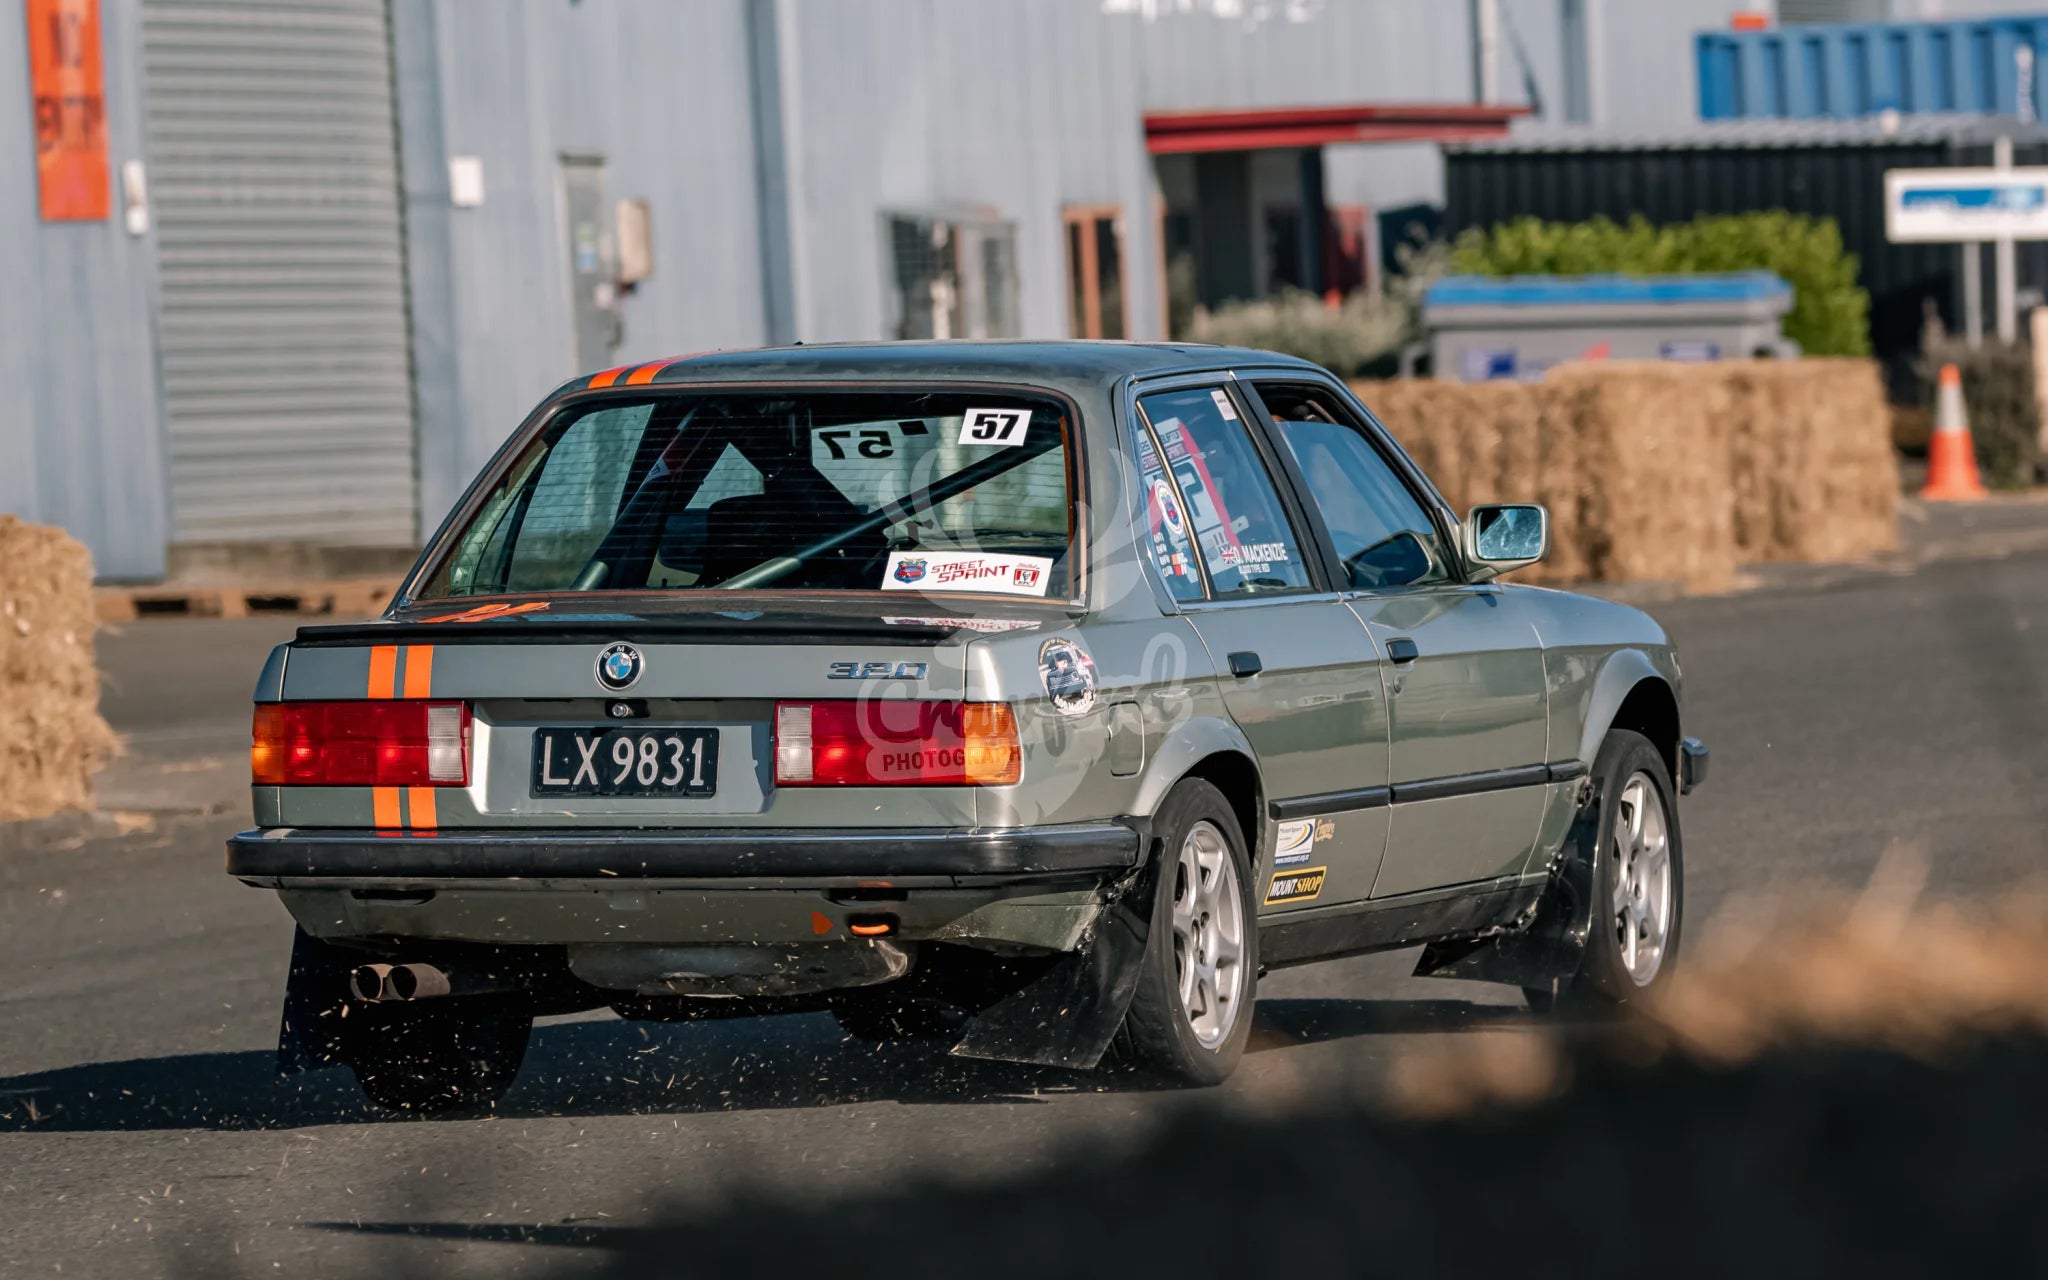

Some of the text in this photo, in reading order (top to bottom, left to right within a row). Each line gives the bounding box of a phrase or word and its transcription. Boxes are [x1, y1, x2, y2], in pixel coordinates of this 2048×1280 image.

[971, 412, 1020, 440] 57
[1241, 543, 1288, 563] MACKENZIE
[931, 560, 986, 574] STREET
[937, 565, 1010, 583] SPRINT
[604, 646, 637, 660] BMW
[827, 662, 928, 680] 320
[1269, 876, 1322, 897] MOUNT SHOP
